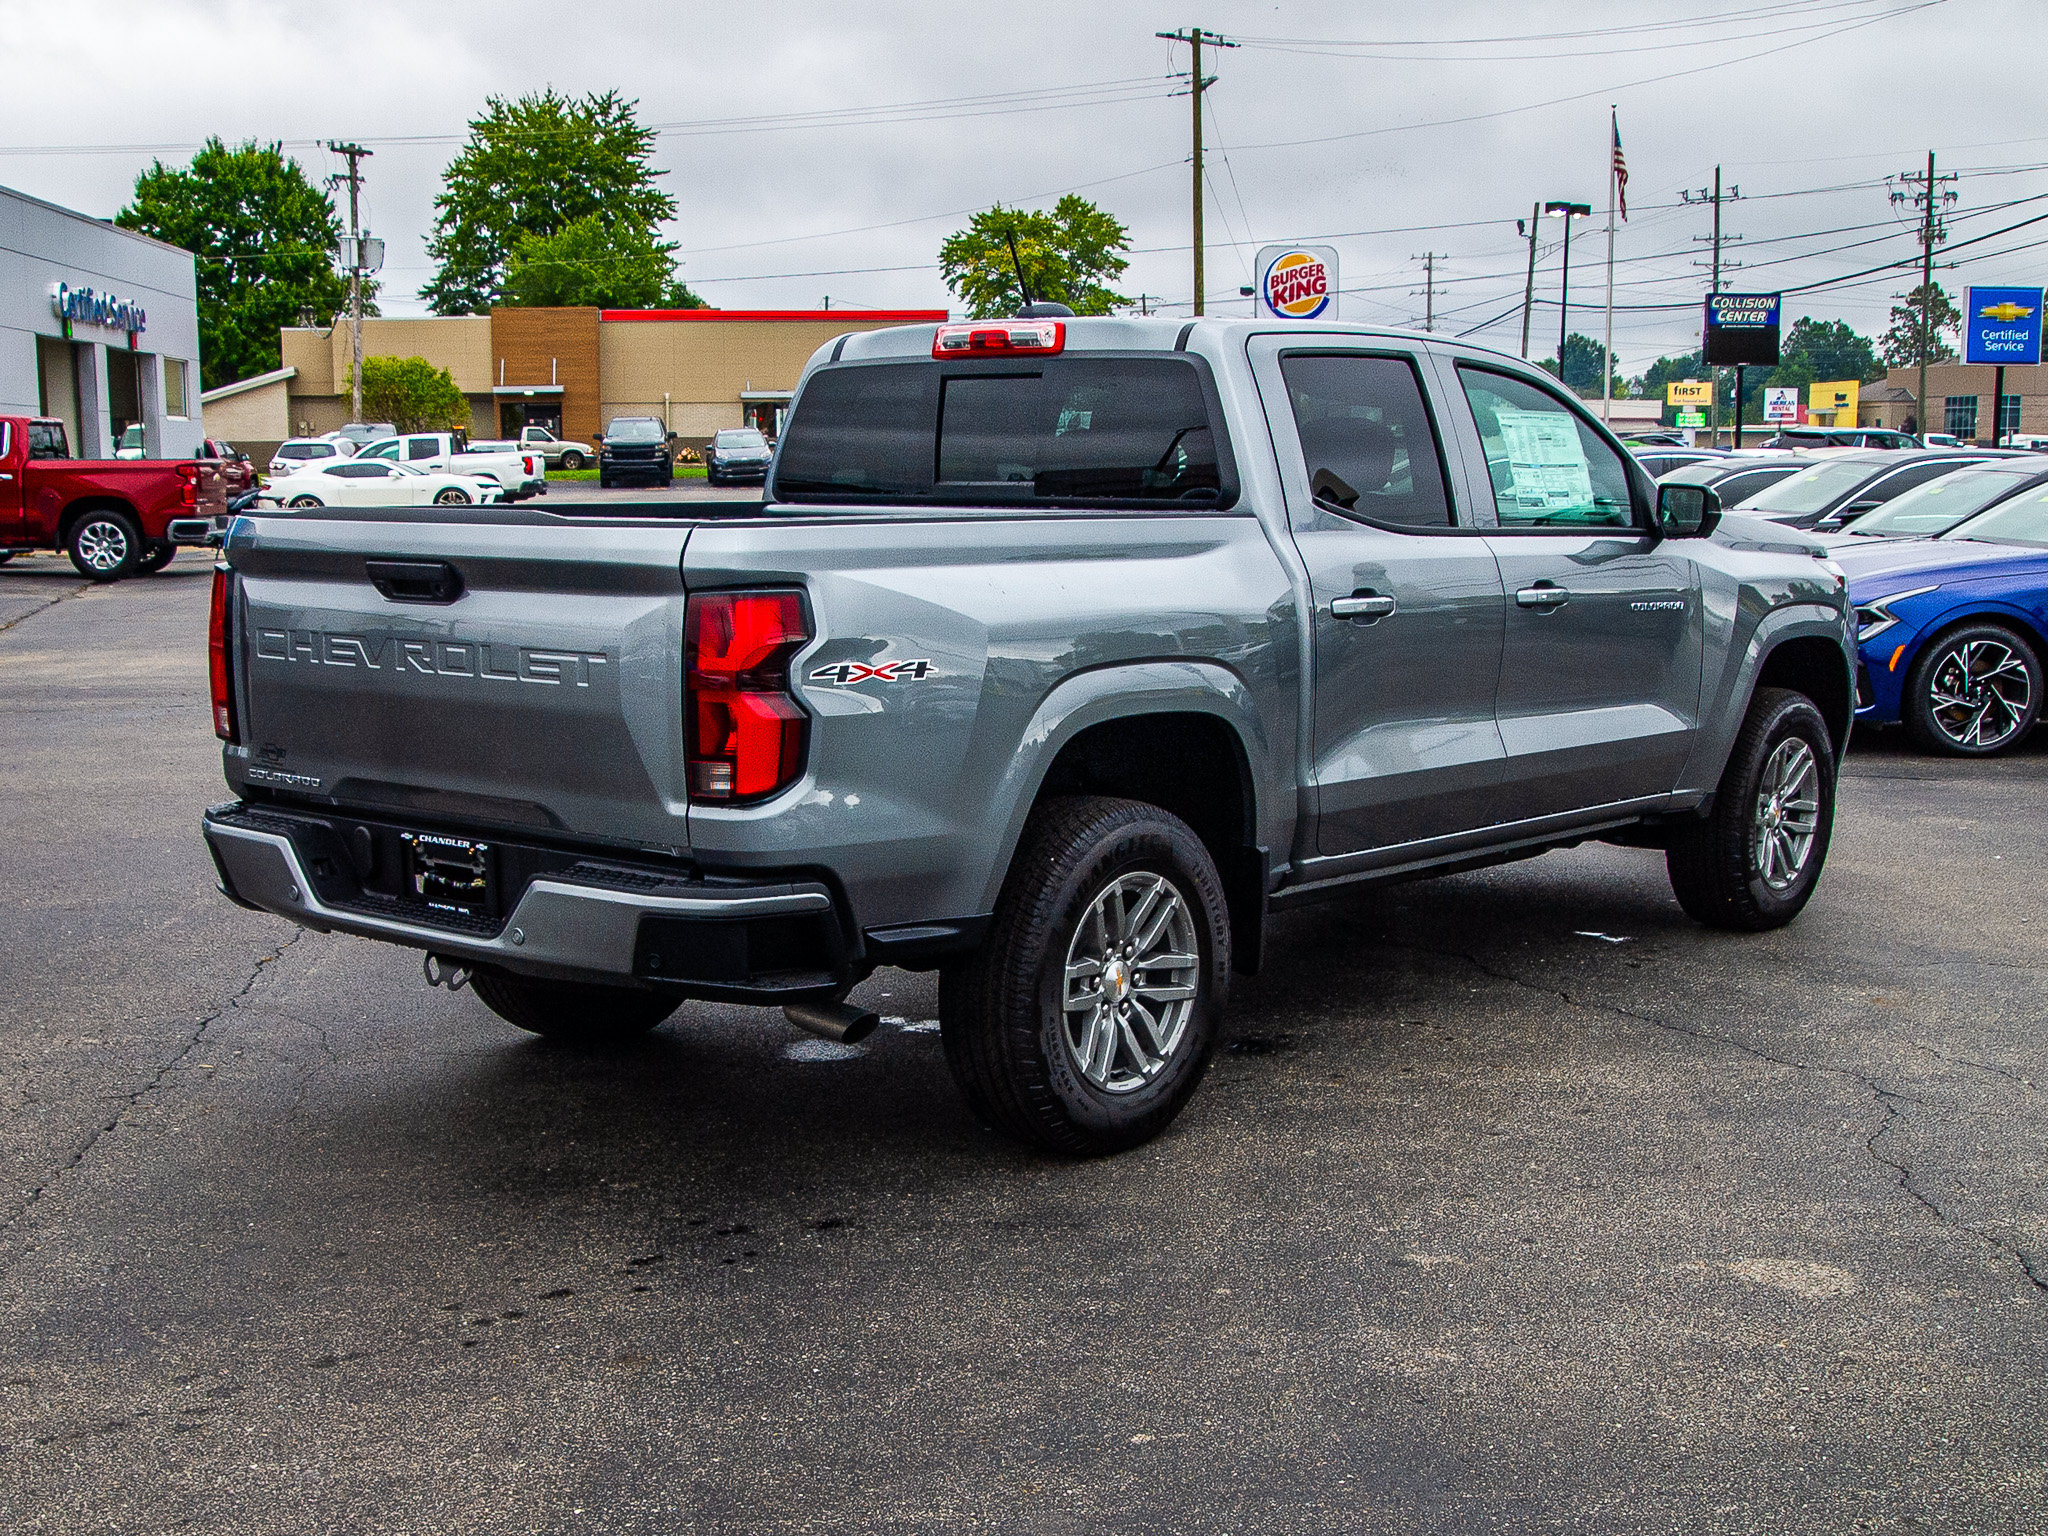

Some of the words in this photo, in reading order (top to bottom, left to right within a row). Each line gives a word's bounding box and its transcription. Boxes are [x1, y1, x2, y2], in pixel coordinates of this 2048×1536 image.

[1270, 263, 1325, 290] BURGER
[1272, 276, 1327, 308] KING
[1711, 296, 1777, 309] COLLISION
[1717, 309, 1767, 322] CENTER
[1981, 329, 2029, 340] Certified
[1984, 340, 2025, 351] Service
[256, 628, 607, 687] CHEVROLET
[248, 768, 321, 787] COLORADO
[419, 834, 471, 849] CHANDLER
